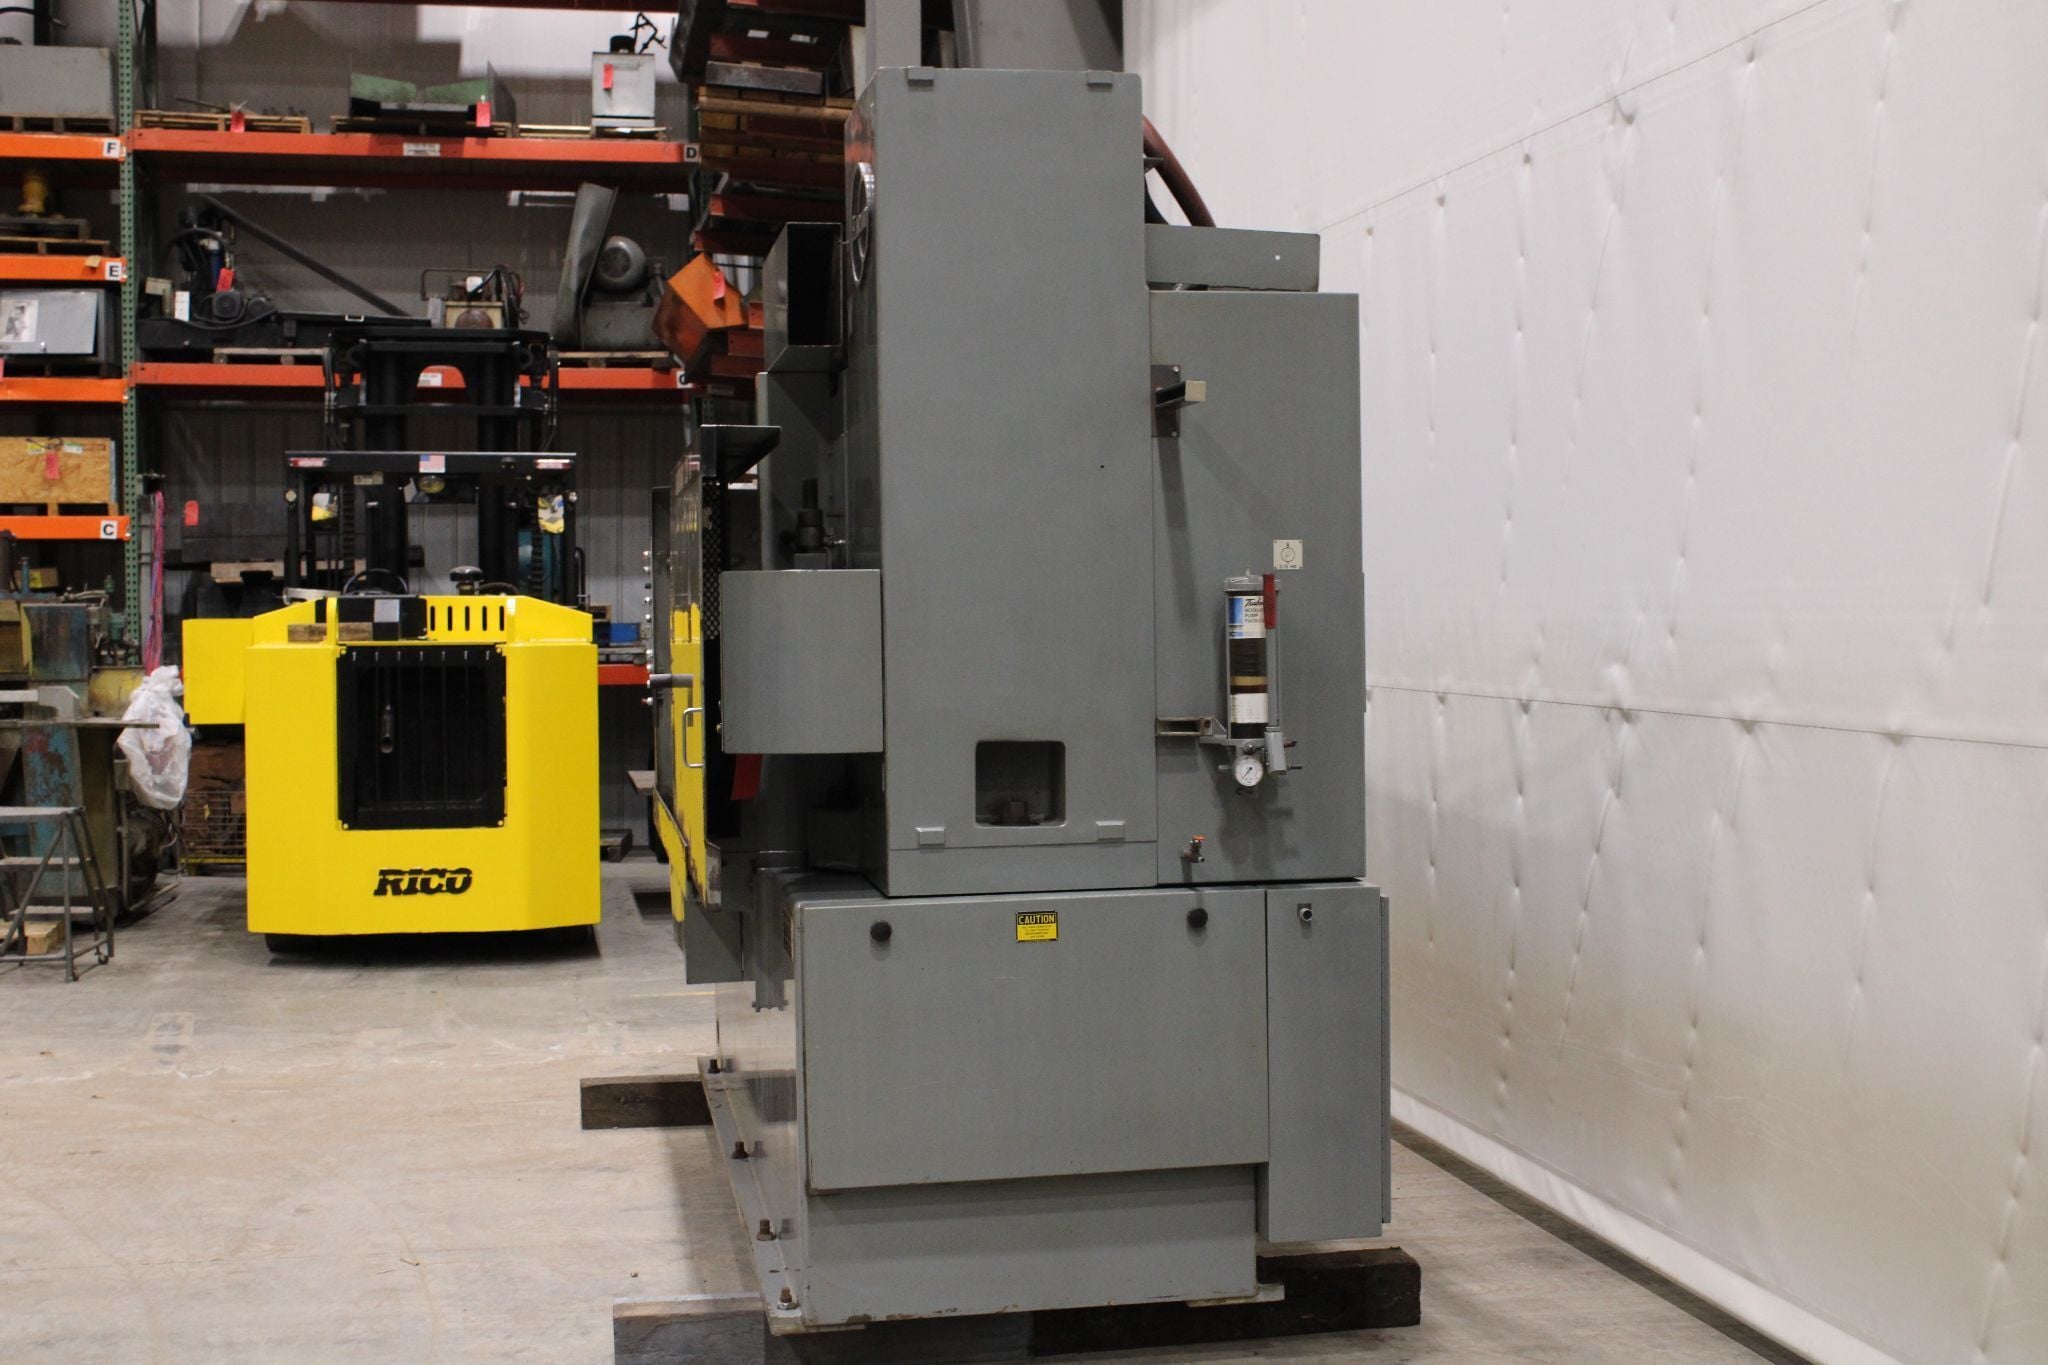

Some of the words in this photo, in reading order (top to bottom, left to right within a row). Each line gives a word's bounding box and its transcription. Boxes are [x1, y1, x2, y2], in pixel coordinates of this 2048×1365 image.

[107, 142, 117, 154] F
[686, 146, 697, 159] D
[109, 265, 119, 277] E
[103, 524, 114, 535] C
[373, 867, 473, 897] RICO
[1018, 914, 1055, 925] CAUTION
